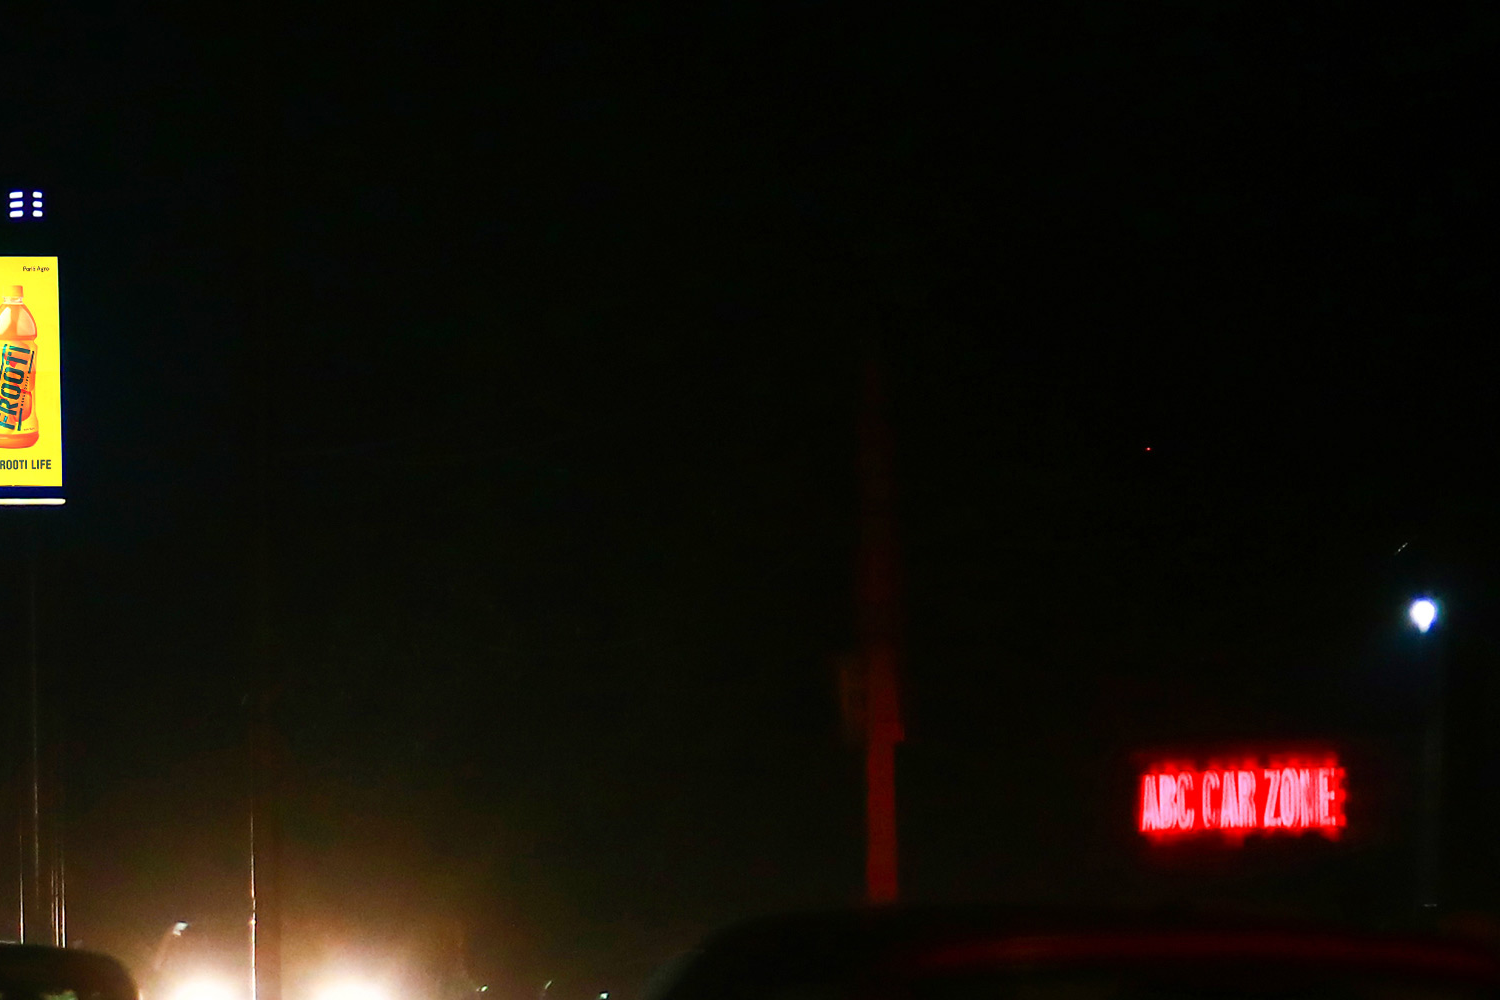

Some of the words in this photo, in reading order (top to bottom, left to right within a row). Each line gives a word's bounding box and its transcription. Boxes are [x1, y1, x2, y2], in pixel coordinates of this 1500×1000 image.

[31, 459, 52, 470] LIFE
[1141, 773, 1195, 832] ABC
[1202, 770, 1258, 829] CAR
[1263, 767, 1337, 828] ZONE
